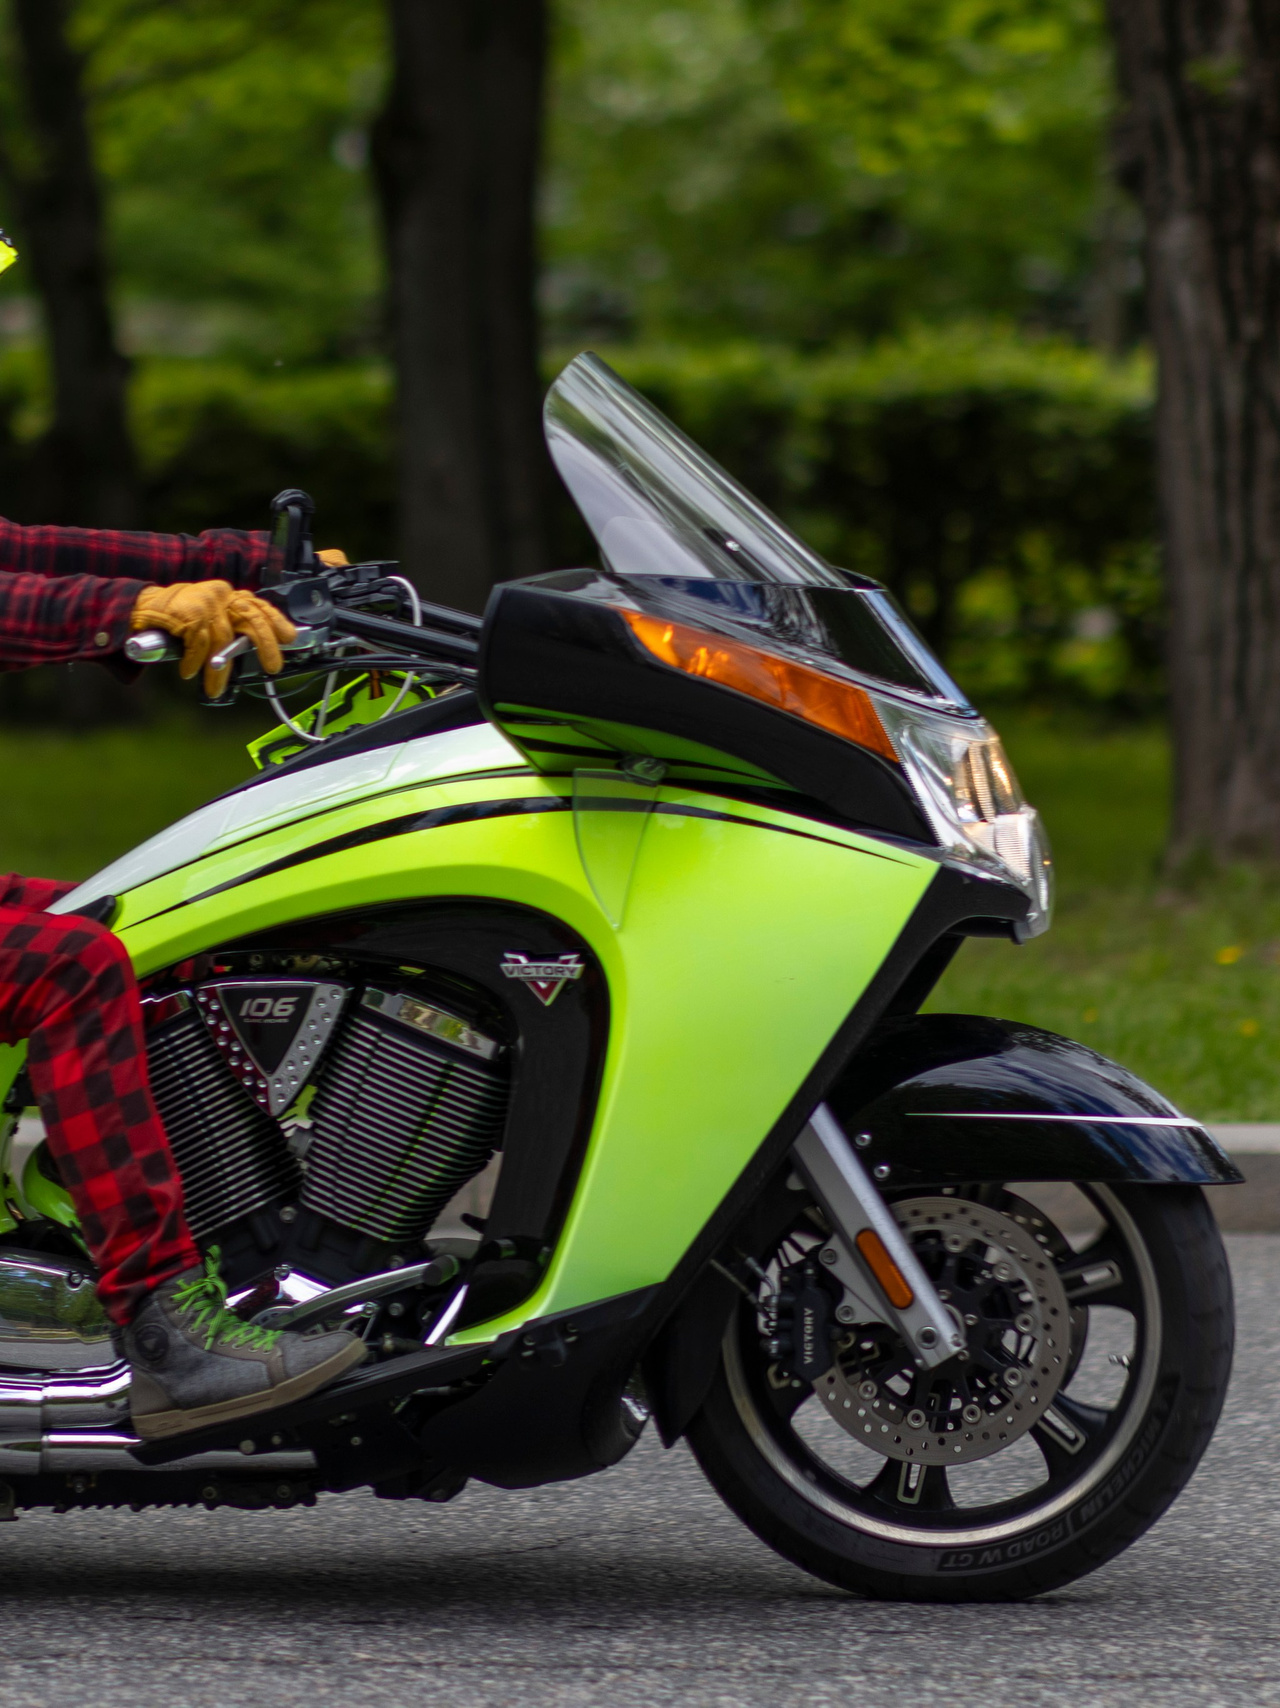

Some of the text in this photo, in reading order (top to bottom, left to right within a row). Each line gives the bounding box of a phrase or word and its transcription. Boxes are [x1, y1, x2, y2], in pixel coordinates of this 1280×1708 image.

[504, 965, 578, 977] VICTORY
[238, 996, 300, 1017] 106
[803, 1307, 814, 1364] VICTORY
[1082, 1417, 1162, 1522] MICHELIN
[1007, 1526, 1065, 1557] ROAD
[943, 1553, 970, 1567] GT
